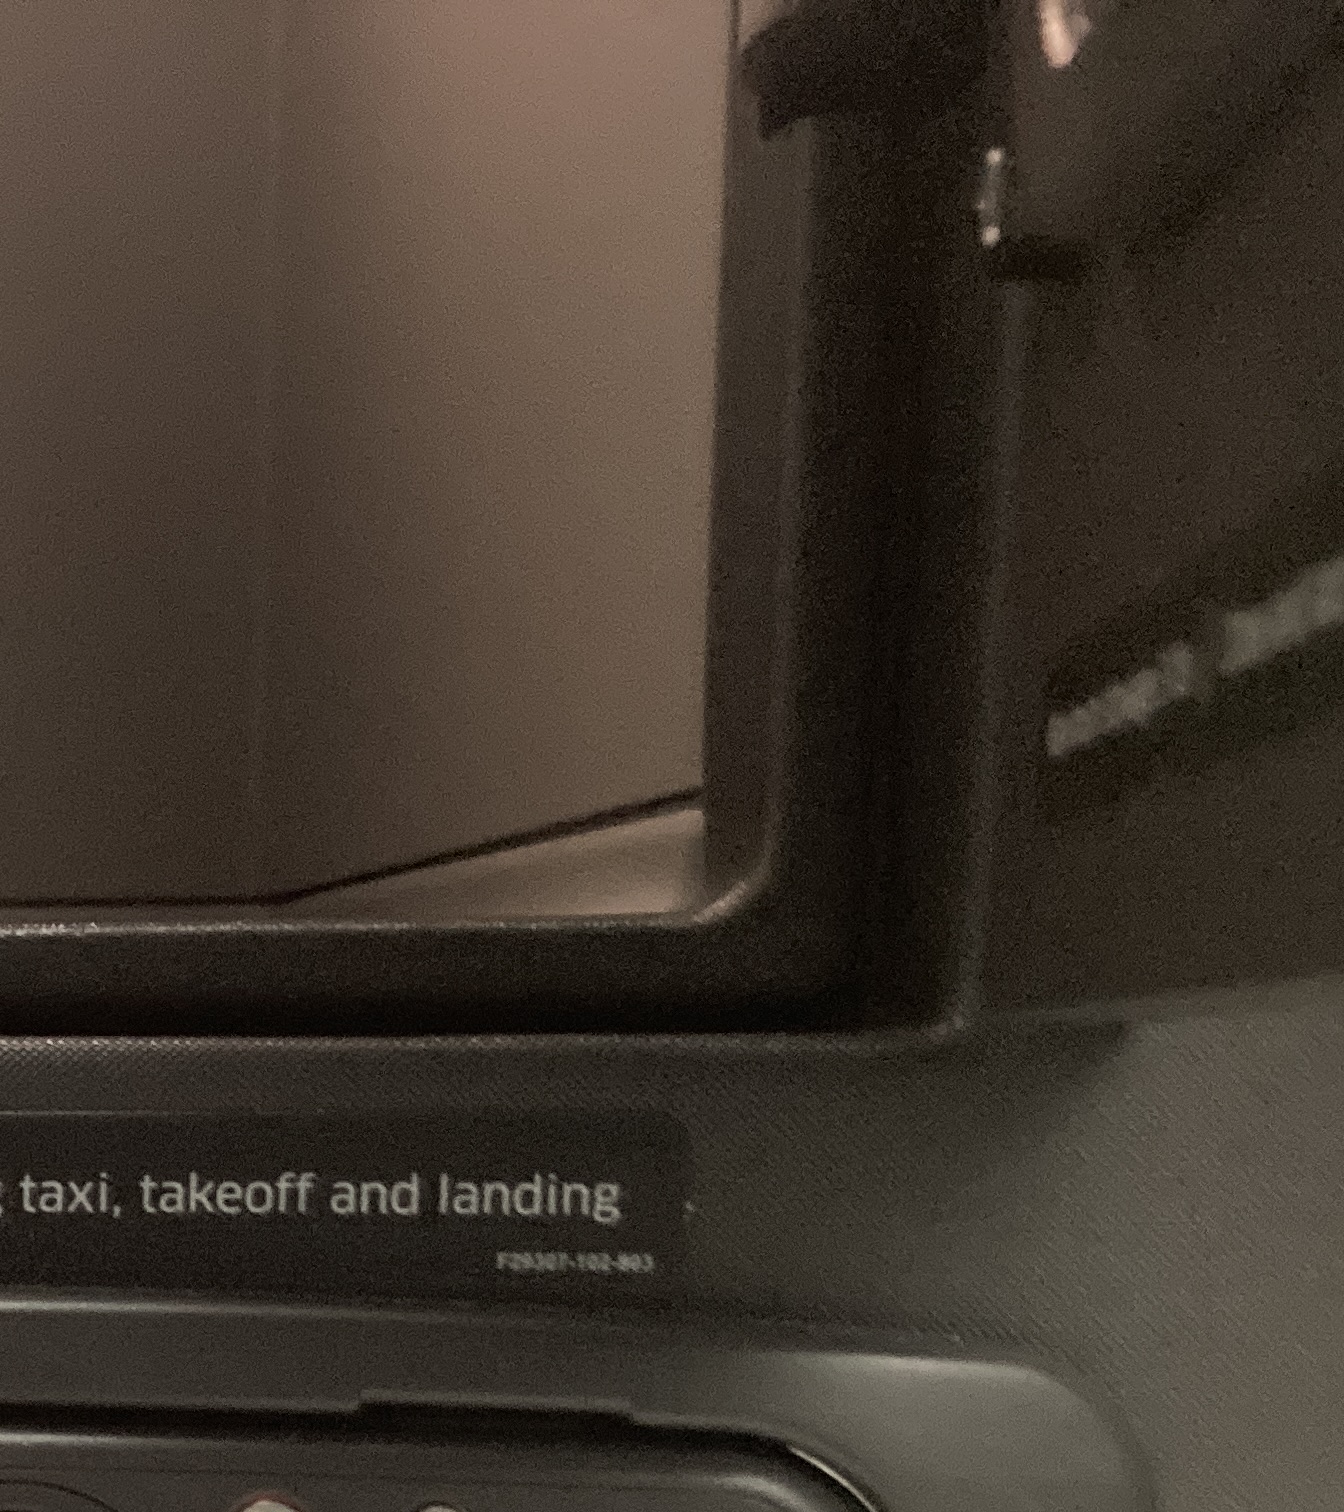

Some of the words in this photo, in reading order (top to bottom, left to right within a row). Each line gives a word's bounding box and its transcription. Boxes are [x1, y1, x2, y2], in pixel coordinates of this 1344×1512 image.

[19, 1174, 121, 1217] taxi,
[139, 1173, 315, 1213] takeoff
[330, 1173, 419, 1214] and
[439, 1173, 621, 1222] landing
